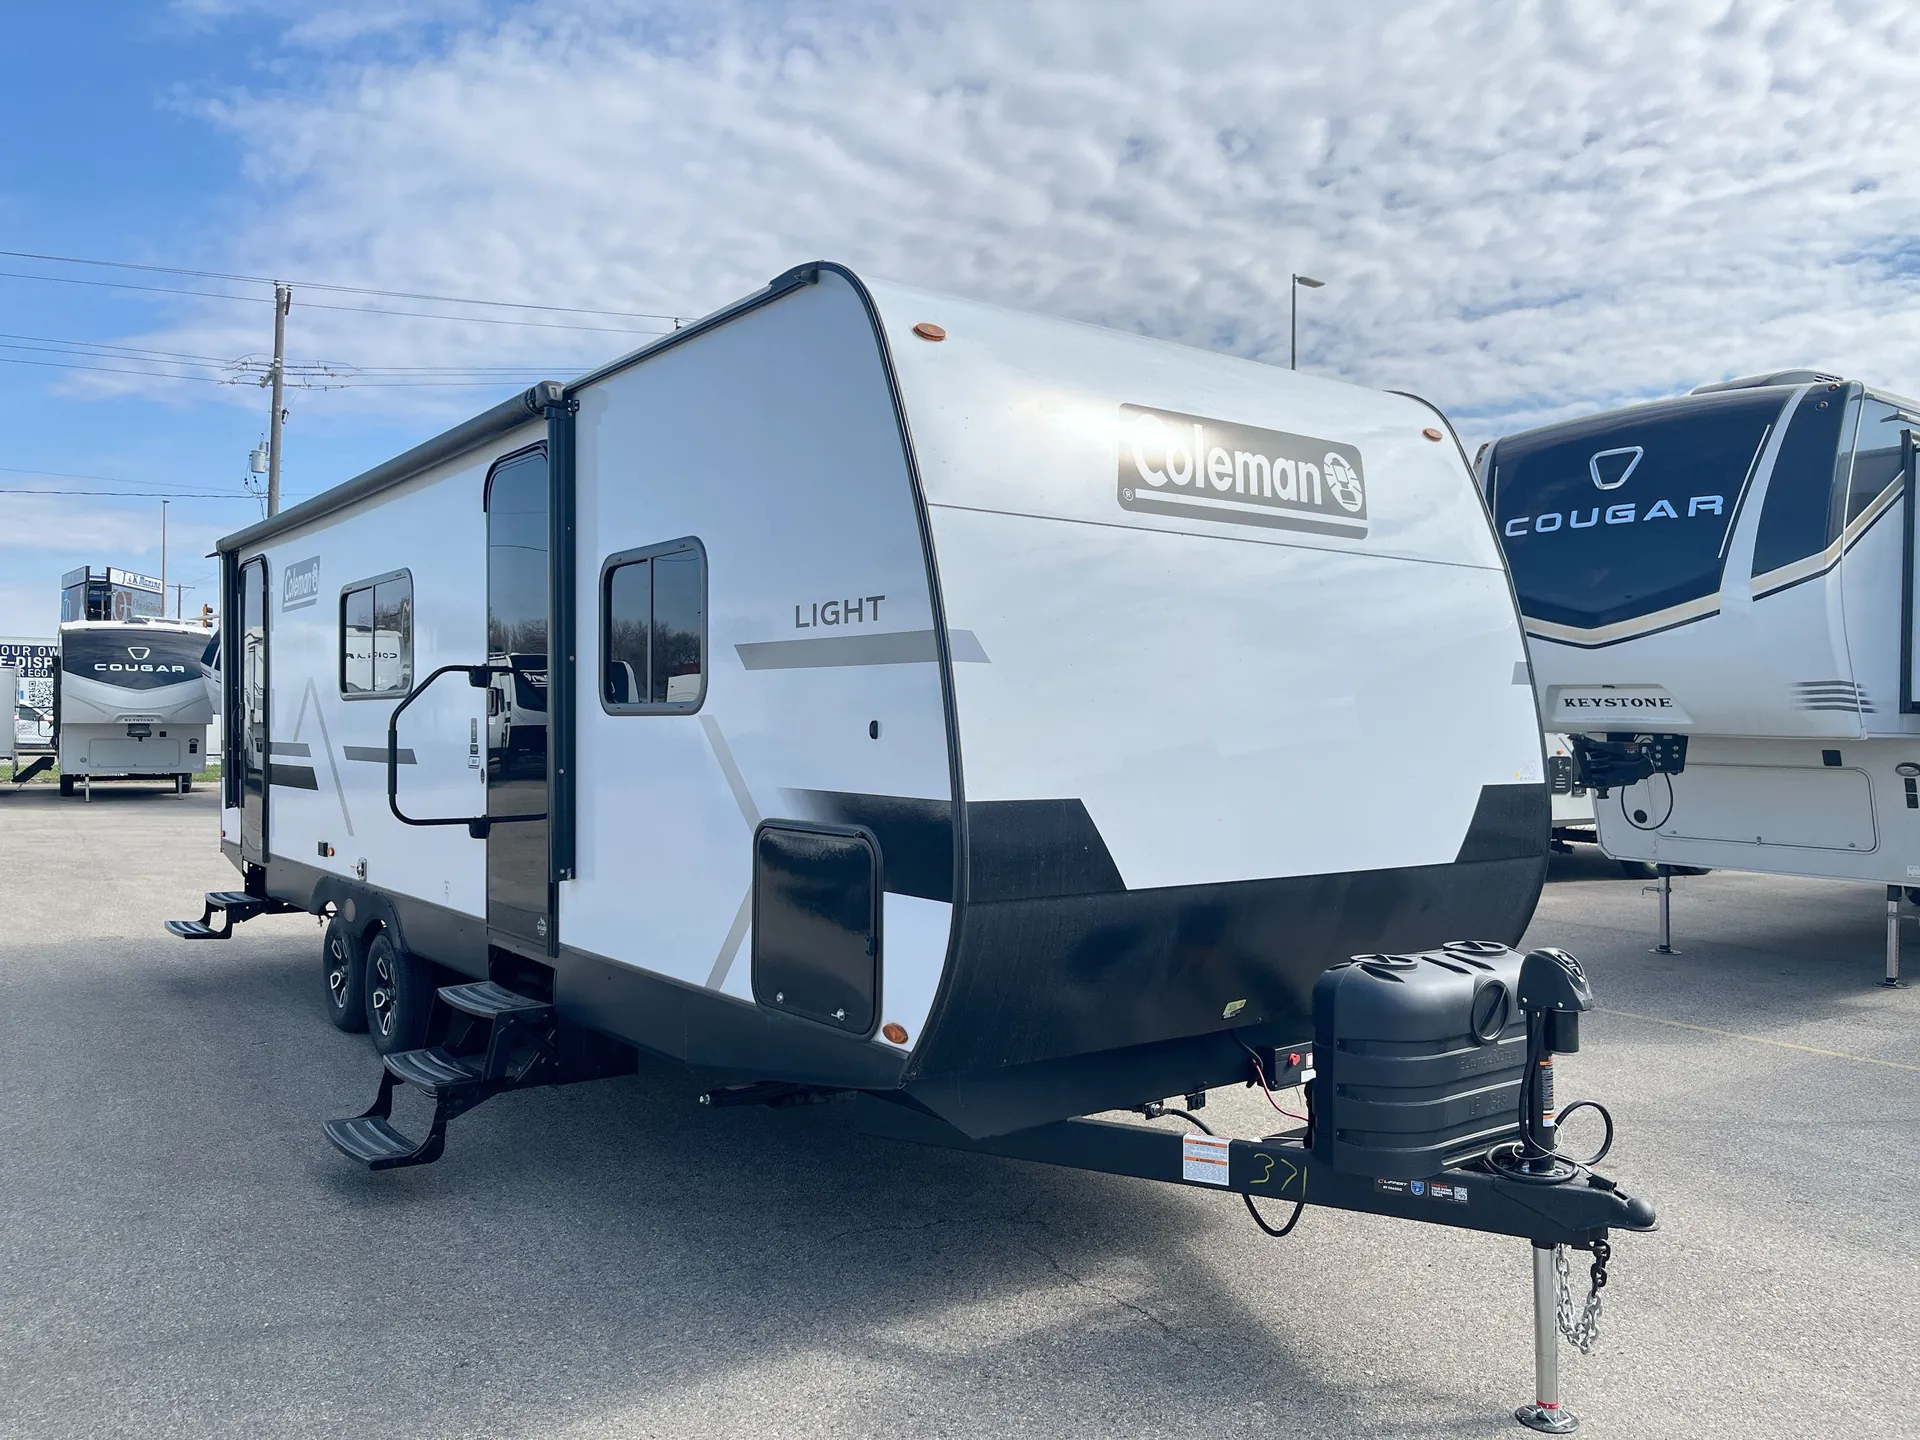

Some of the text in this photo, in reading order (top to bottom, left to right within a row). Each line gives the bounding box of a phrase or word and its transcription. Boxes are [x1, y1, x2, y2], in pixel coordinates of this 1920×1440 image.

[1132, 413, 1323, 505] Coleman
[1504, 494, 1724, 537] COUGAR
[284, 567, 312, 601] Coleman
[795, 595, 886, 628] LIGHT
[28, 668, 48, 677] EGO
[94, 663, 185, 673] COUGAR
[1563, 698, 1673, 708] KEYSTONE
[1249, 1153, 1308, 1199] 371
